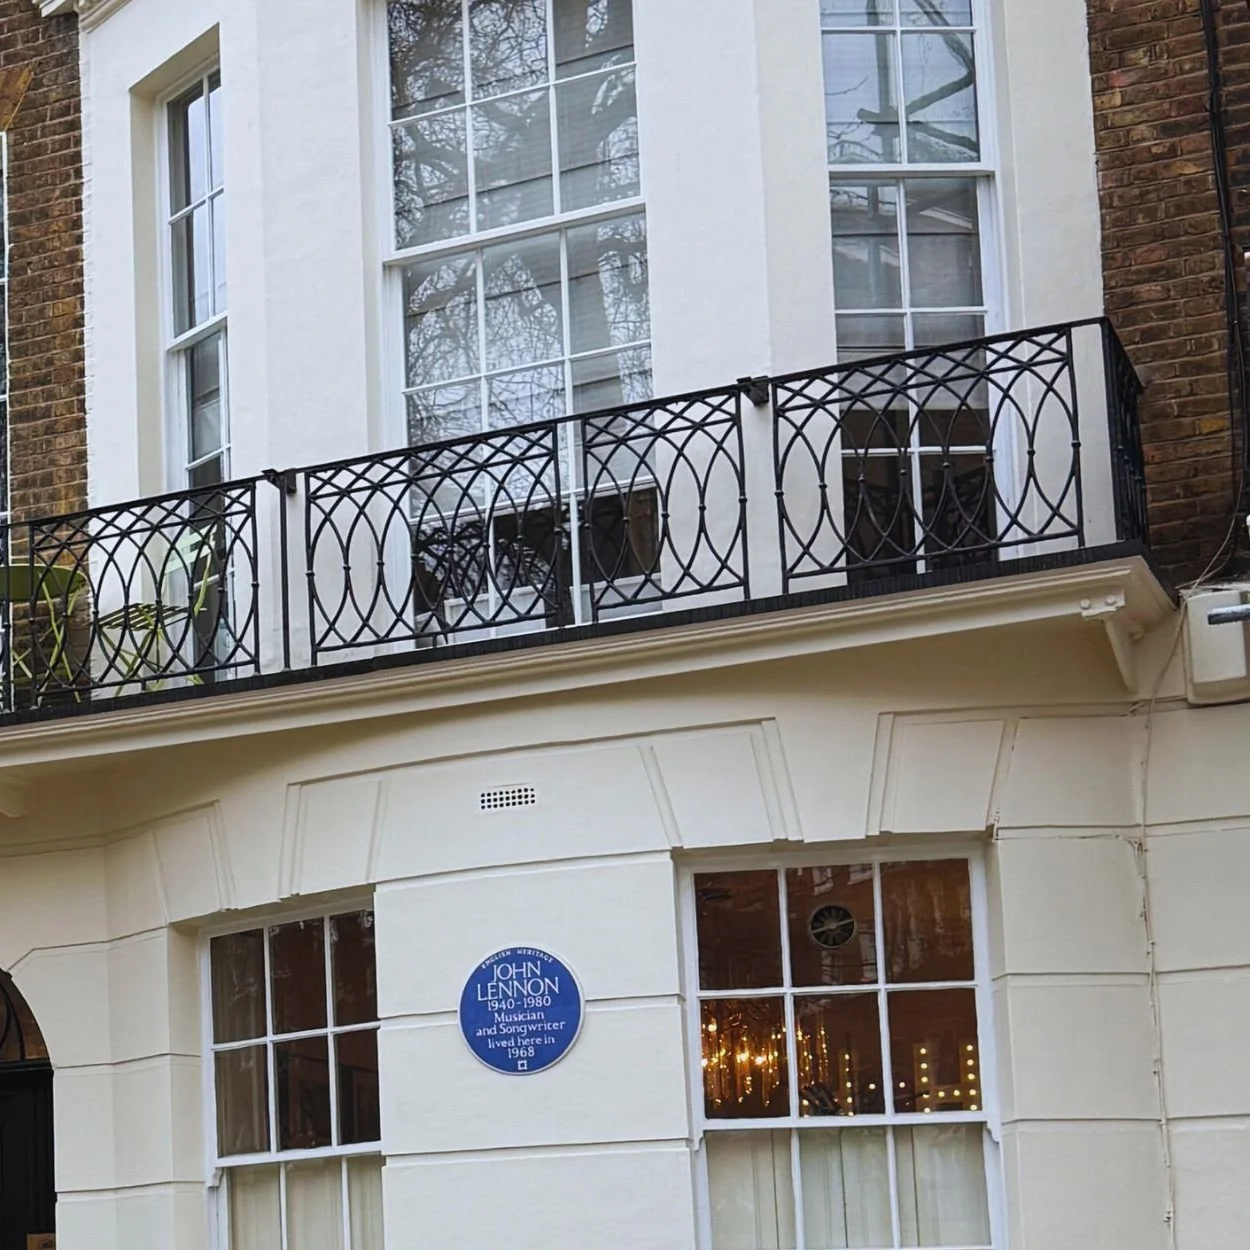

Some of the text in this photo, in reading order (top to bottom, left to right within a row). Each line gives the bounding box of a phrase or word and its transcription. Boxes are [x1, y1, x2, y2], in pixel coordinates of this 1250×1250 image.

[493, 960, 541, 982] JOHN
[477, 976, 559, 1001] LENNON
[494, 1010, 545, 1023] Musician
[476, 1020, 566, 1037] and Songwriter
[487, 1033, 556, 1049] lived here in
[507, 1046, 535, 1059] 1968
